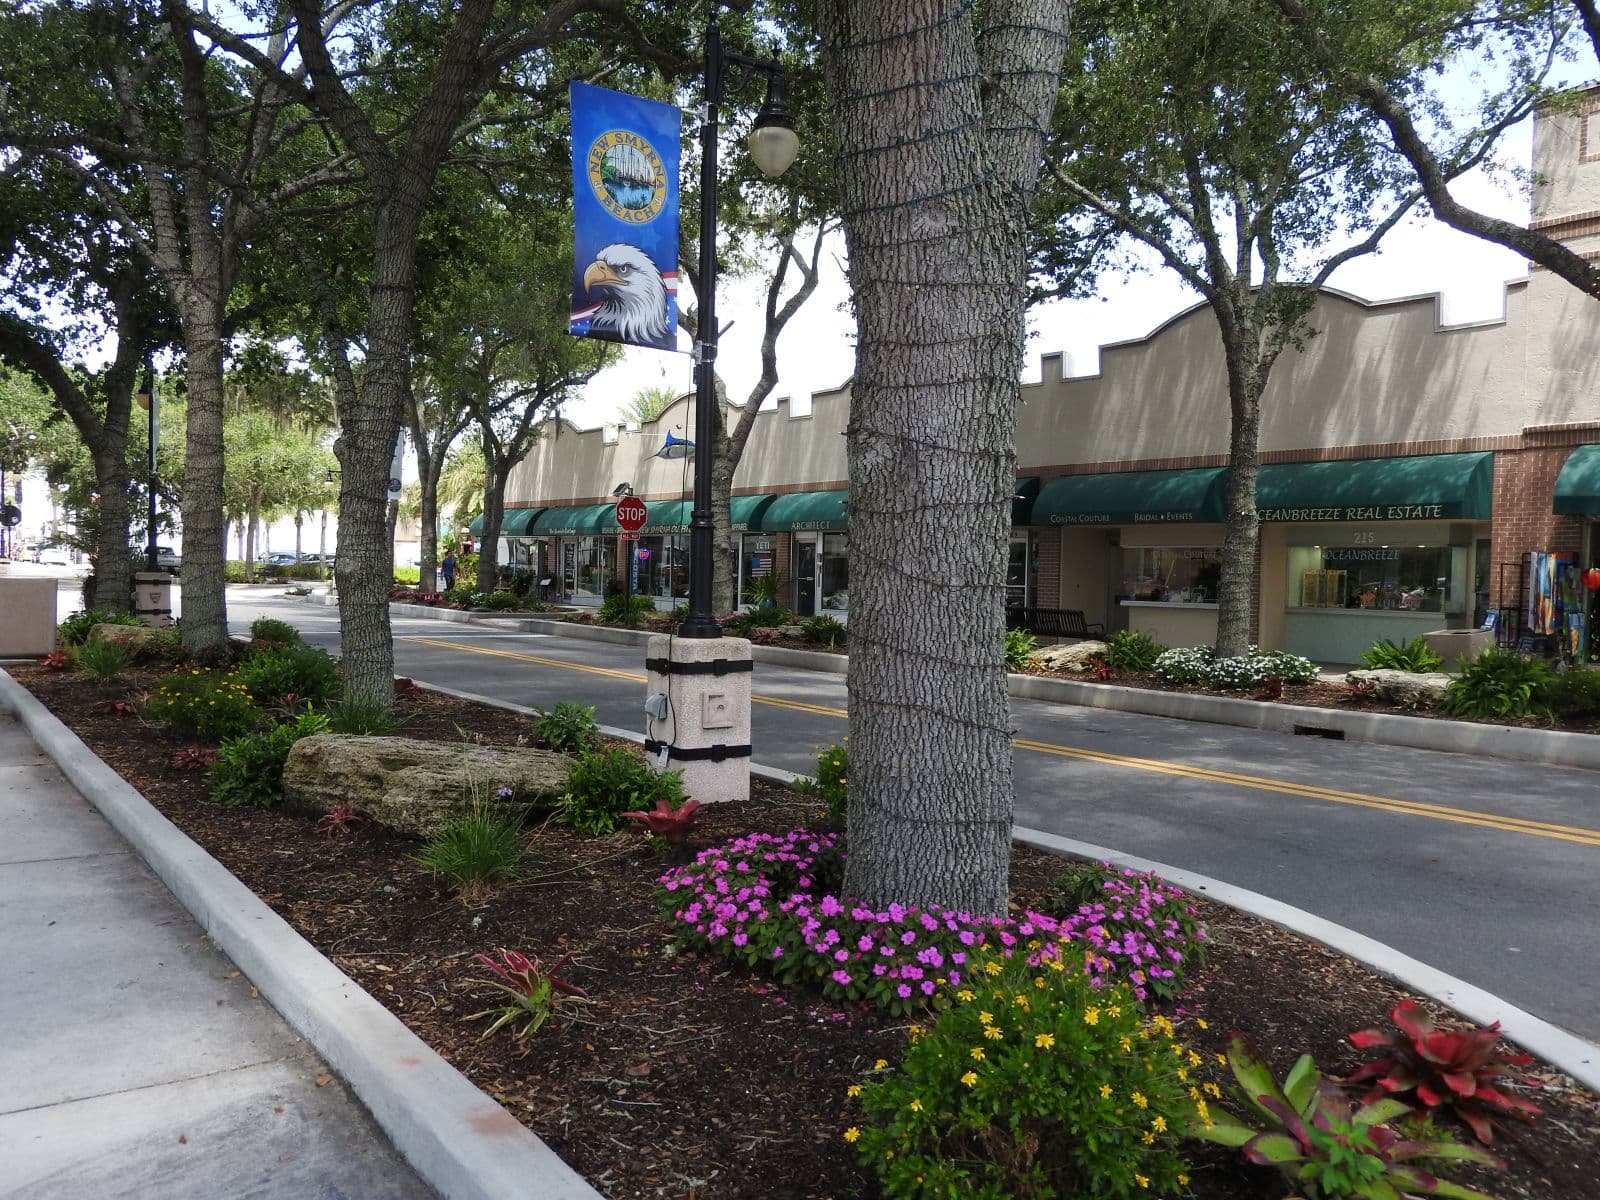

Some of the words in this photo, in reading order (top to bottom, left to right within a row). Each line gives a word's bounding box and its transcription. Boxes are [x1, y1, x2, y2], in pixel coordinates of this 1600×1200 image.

[590, 136, 609, 173] NEW
[614, 132, 665, 189] SMYRNA
[603, 195, 655, 222] BEACH
[618, 507, 646, 521] STOP
[1257, 508, 1341, 521] CEANBREEZE
[1346, 506, 1385, 520] REAL
[1388, 504, 1444, 519] ESTATE
[791, 521, 830, 530] ARCHITECT
[1353, 532, 1375, 544] 215
[755, 541, 770, 550] YETI
